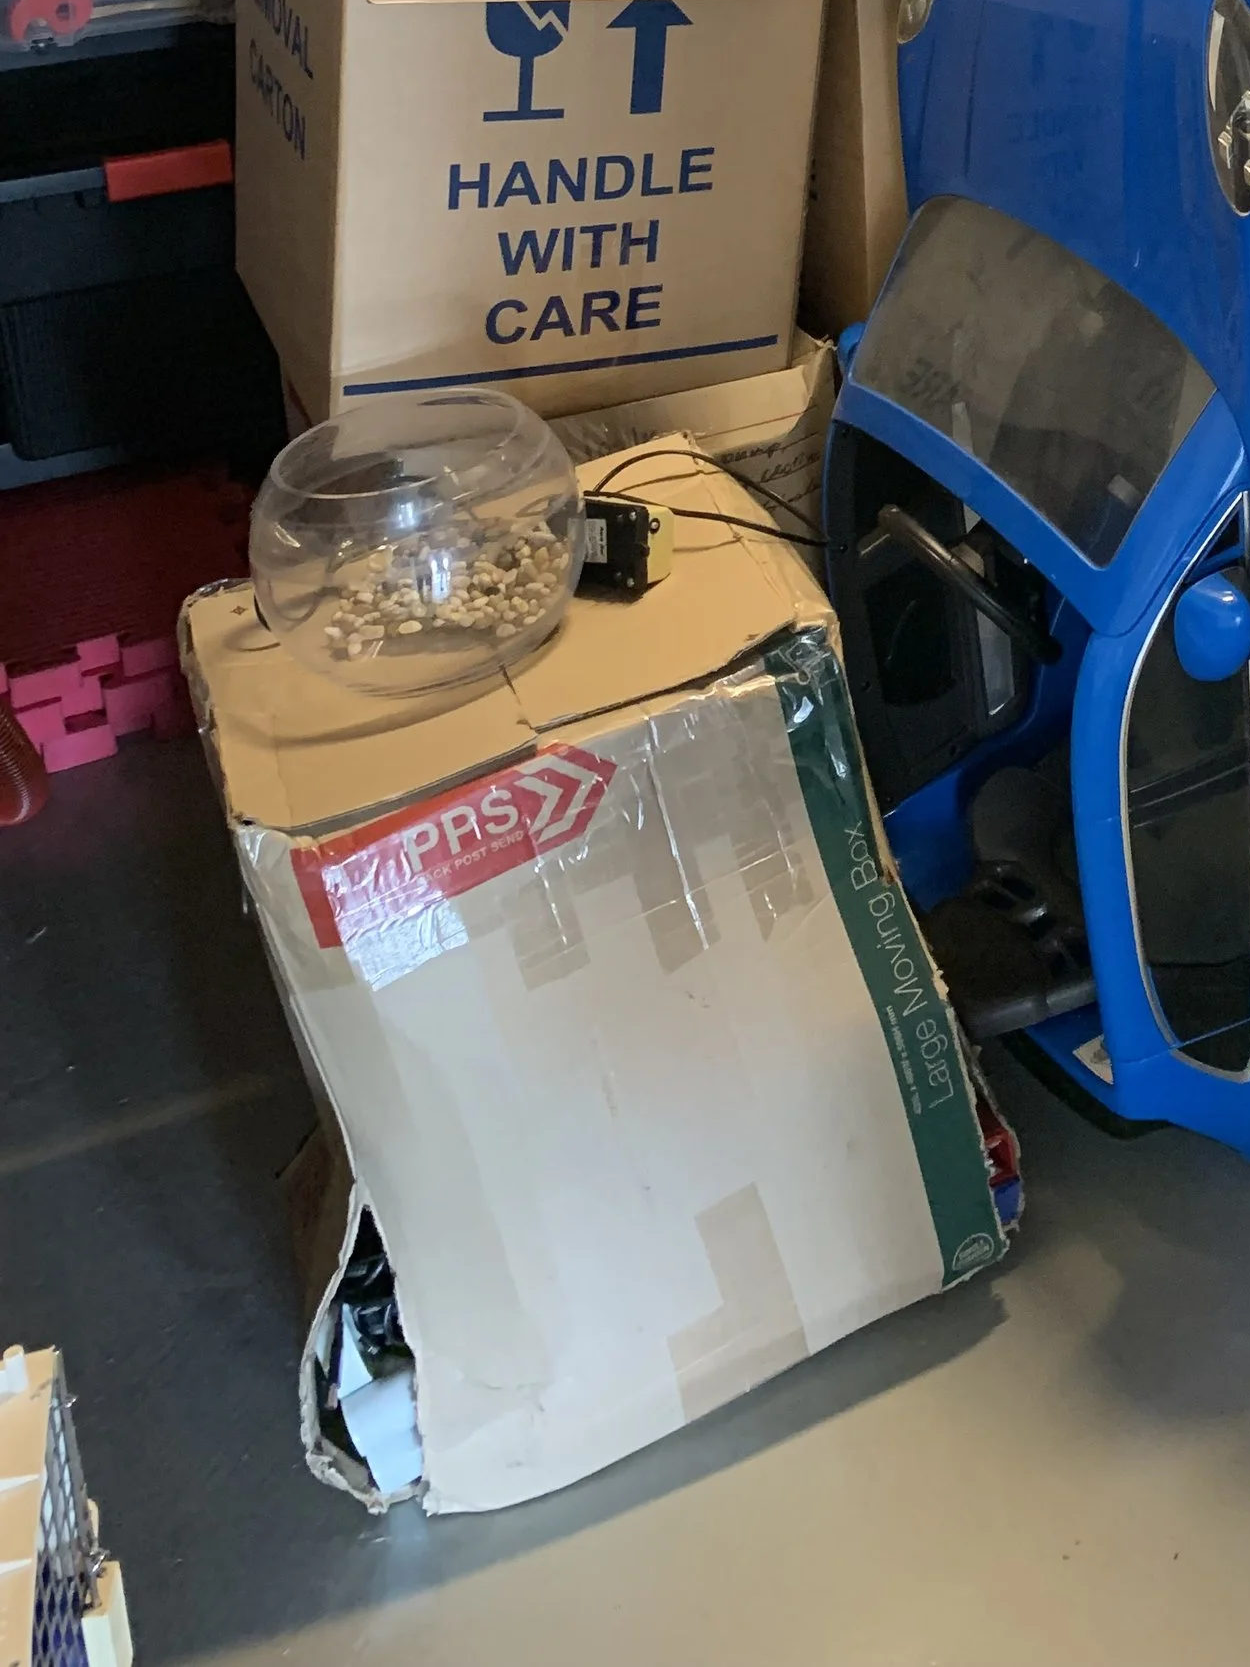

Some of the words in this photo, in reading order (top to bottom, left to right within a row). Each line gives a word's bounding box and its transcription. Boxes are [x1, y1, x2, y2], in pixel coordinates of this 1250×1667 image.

[249, 36, 307, 161] CARTON
[448, 147, 715, 211] HANDLE
[498, 219, 660, 276] WITH
[485, 284, 664, 345] CARE
[454, 846, 488, 871] POST
[490, 830, 525, 852] SEND
[844, 821, 878, 892] Box
[869, 890, 928, 1017] Moving
[916, 1019, 954, 1109] Large
